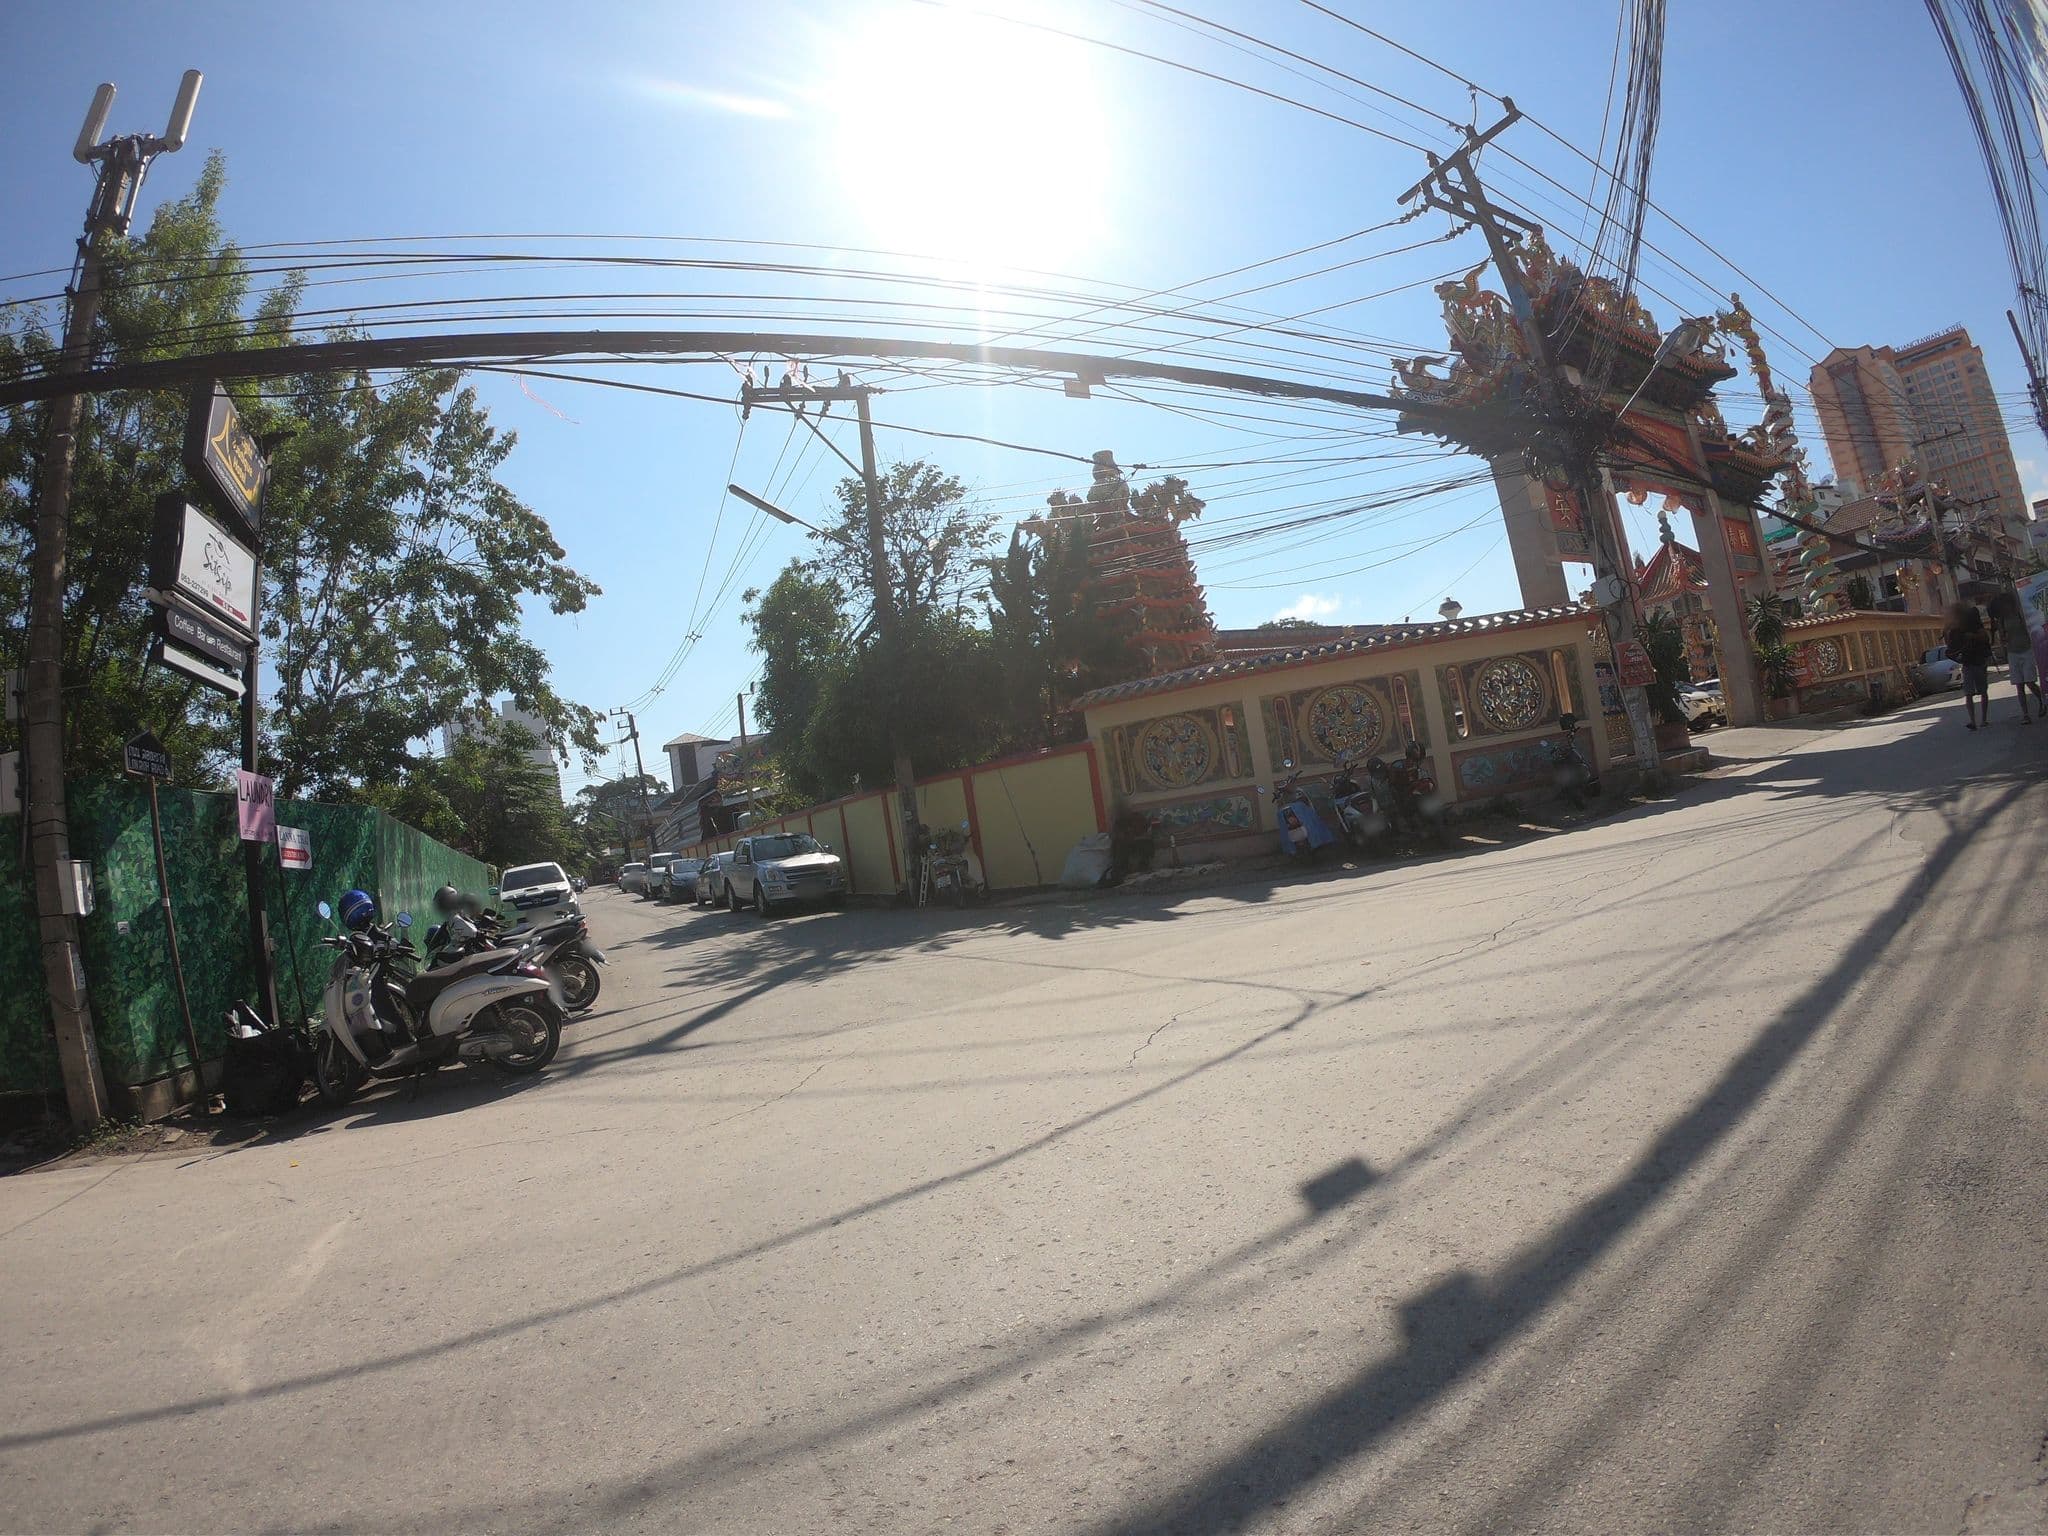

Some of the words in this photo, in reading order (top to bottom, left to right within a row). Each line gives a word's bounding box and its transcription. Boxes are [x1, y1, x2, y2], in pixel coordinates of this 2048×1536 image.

[174, 614, 195, 636] Coffee
[196, 626, 206, 643] Bar
[216, 638, 242, 663] Restaurant
[239, 779, 273, 808] LAUNDRY
